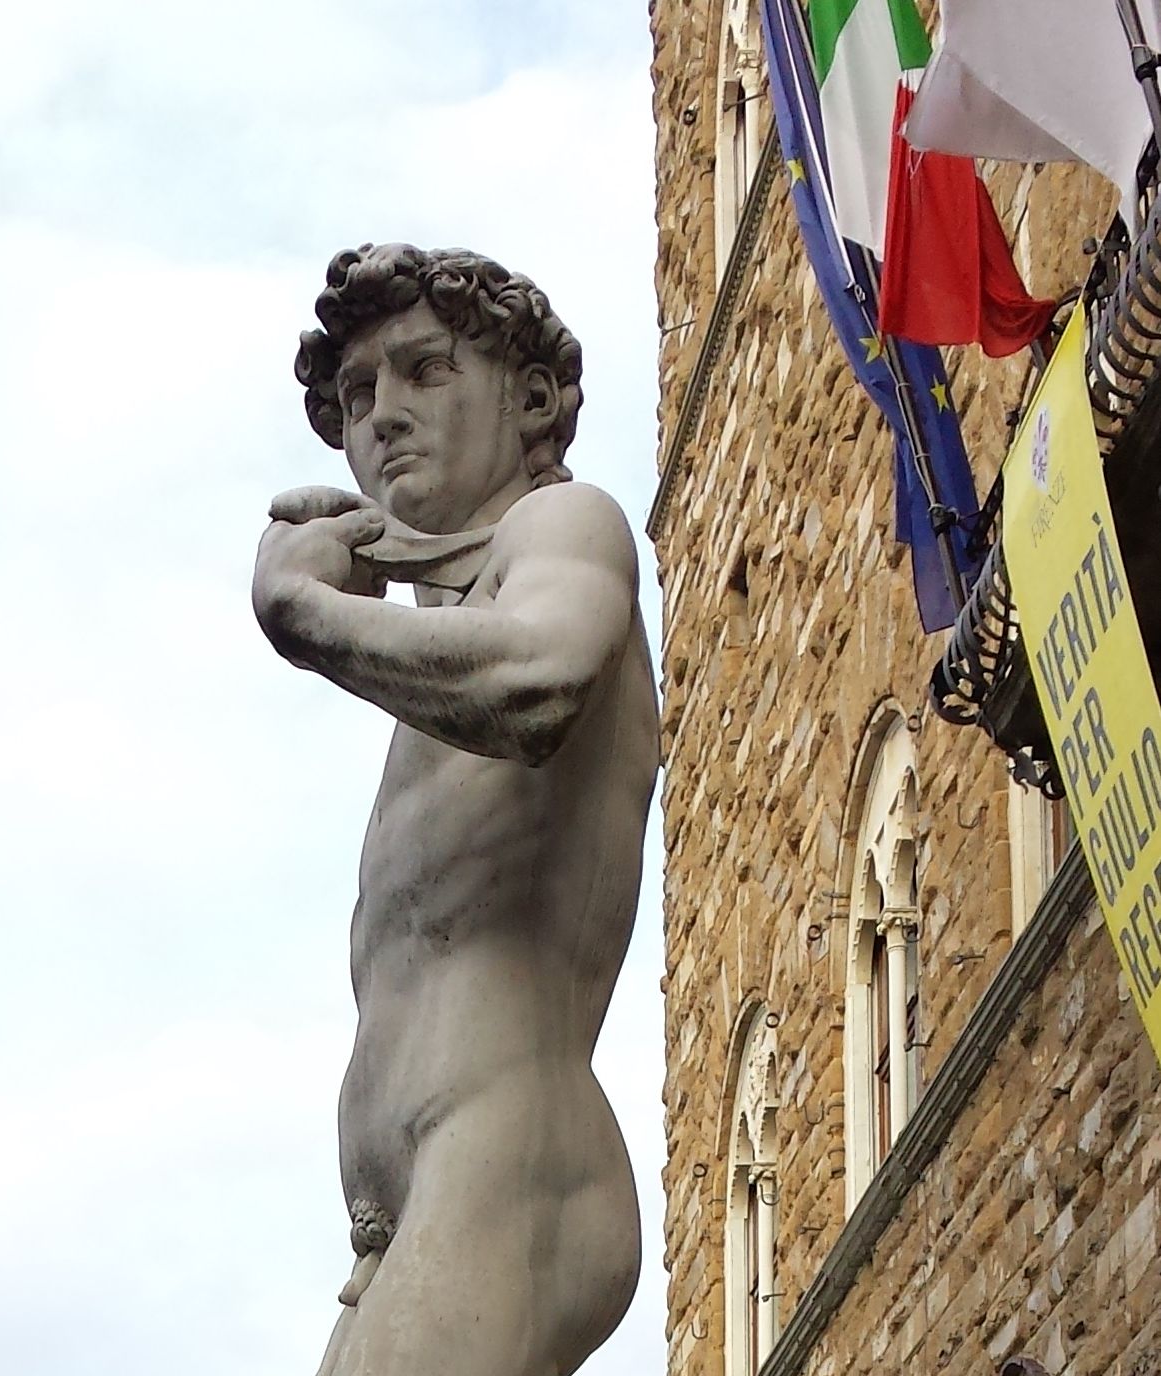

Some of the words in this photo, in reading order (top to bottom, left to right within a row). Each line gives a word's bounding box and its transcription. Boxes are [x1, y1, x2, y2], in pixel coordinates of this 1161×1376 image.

[1036, 511, 1124, 721] VERITÀ
[1061, 686, 1115, 820] PER
[1088, 726, 1161, 907] GIULIO
[1119, 859, 1161, 1009] REG
